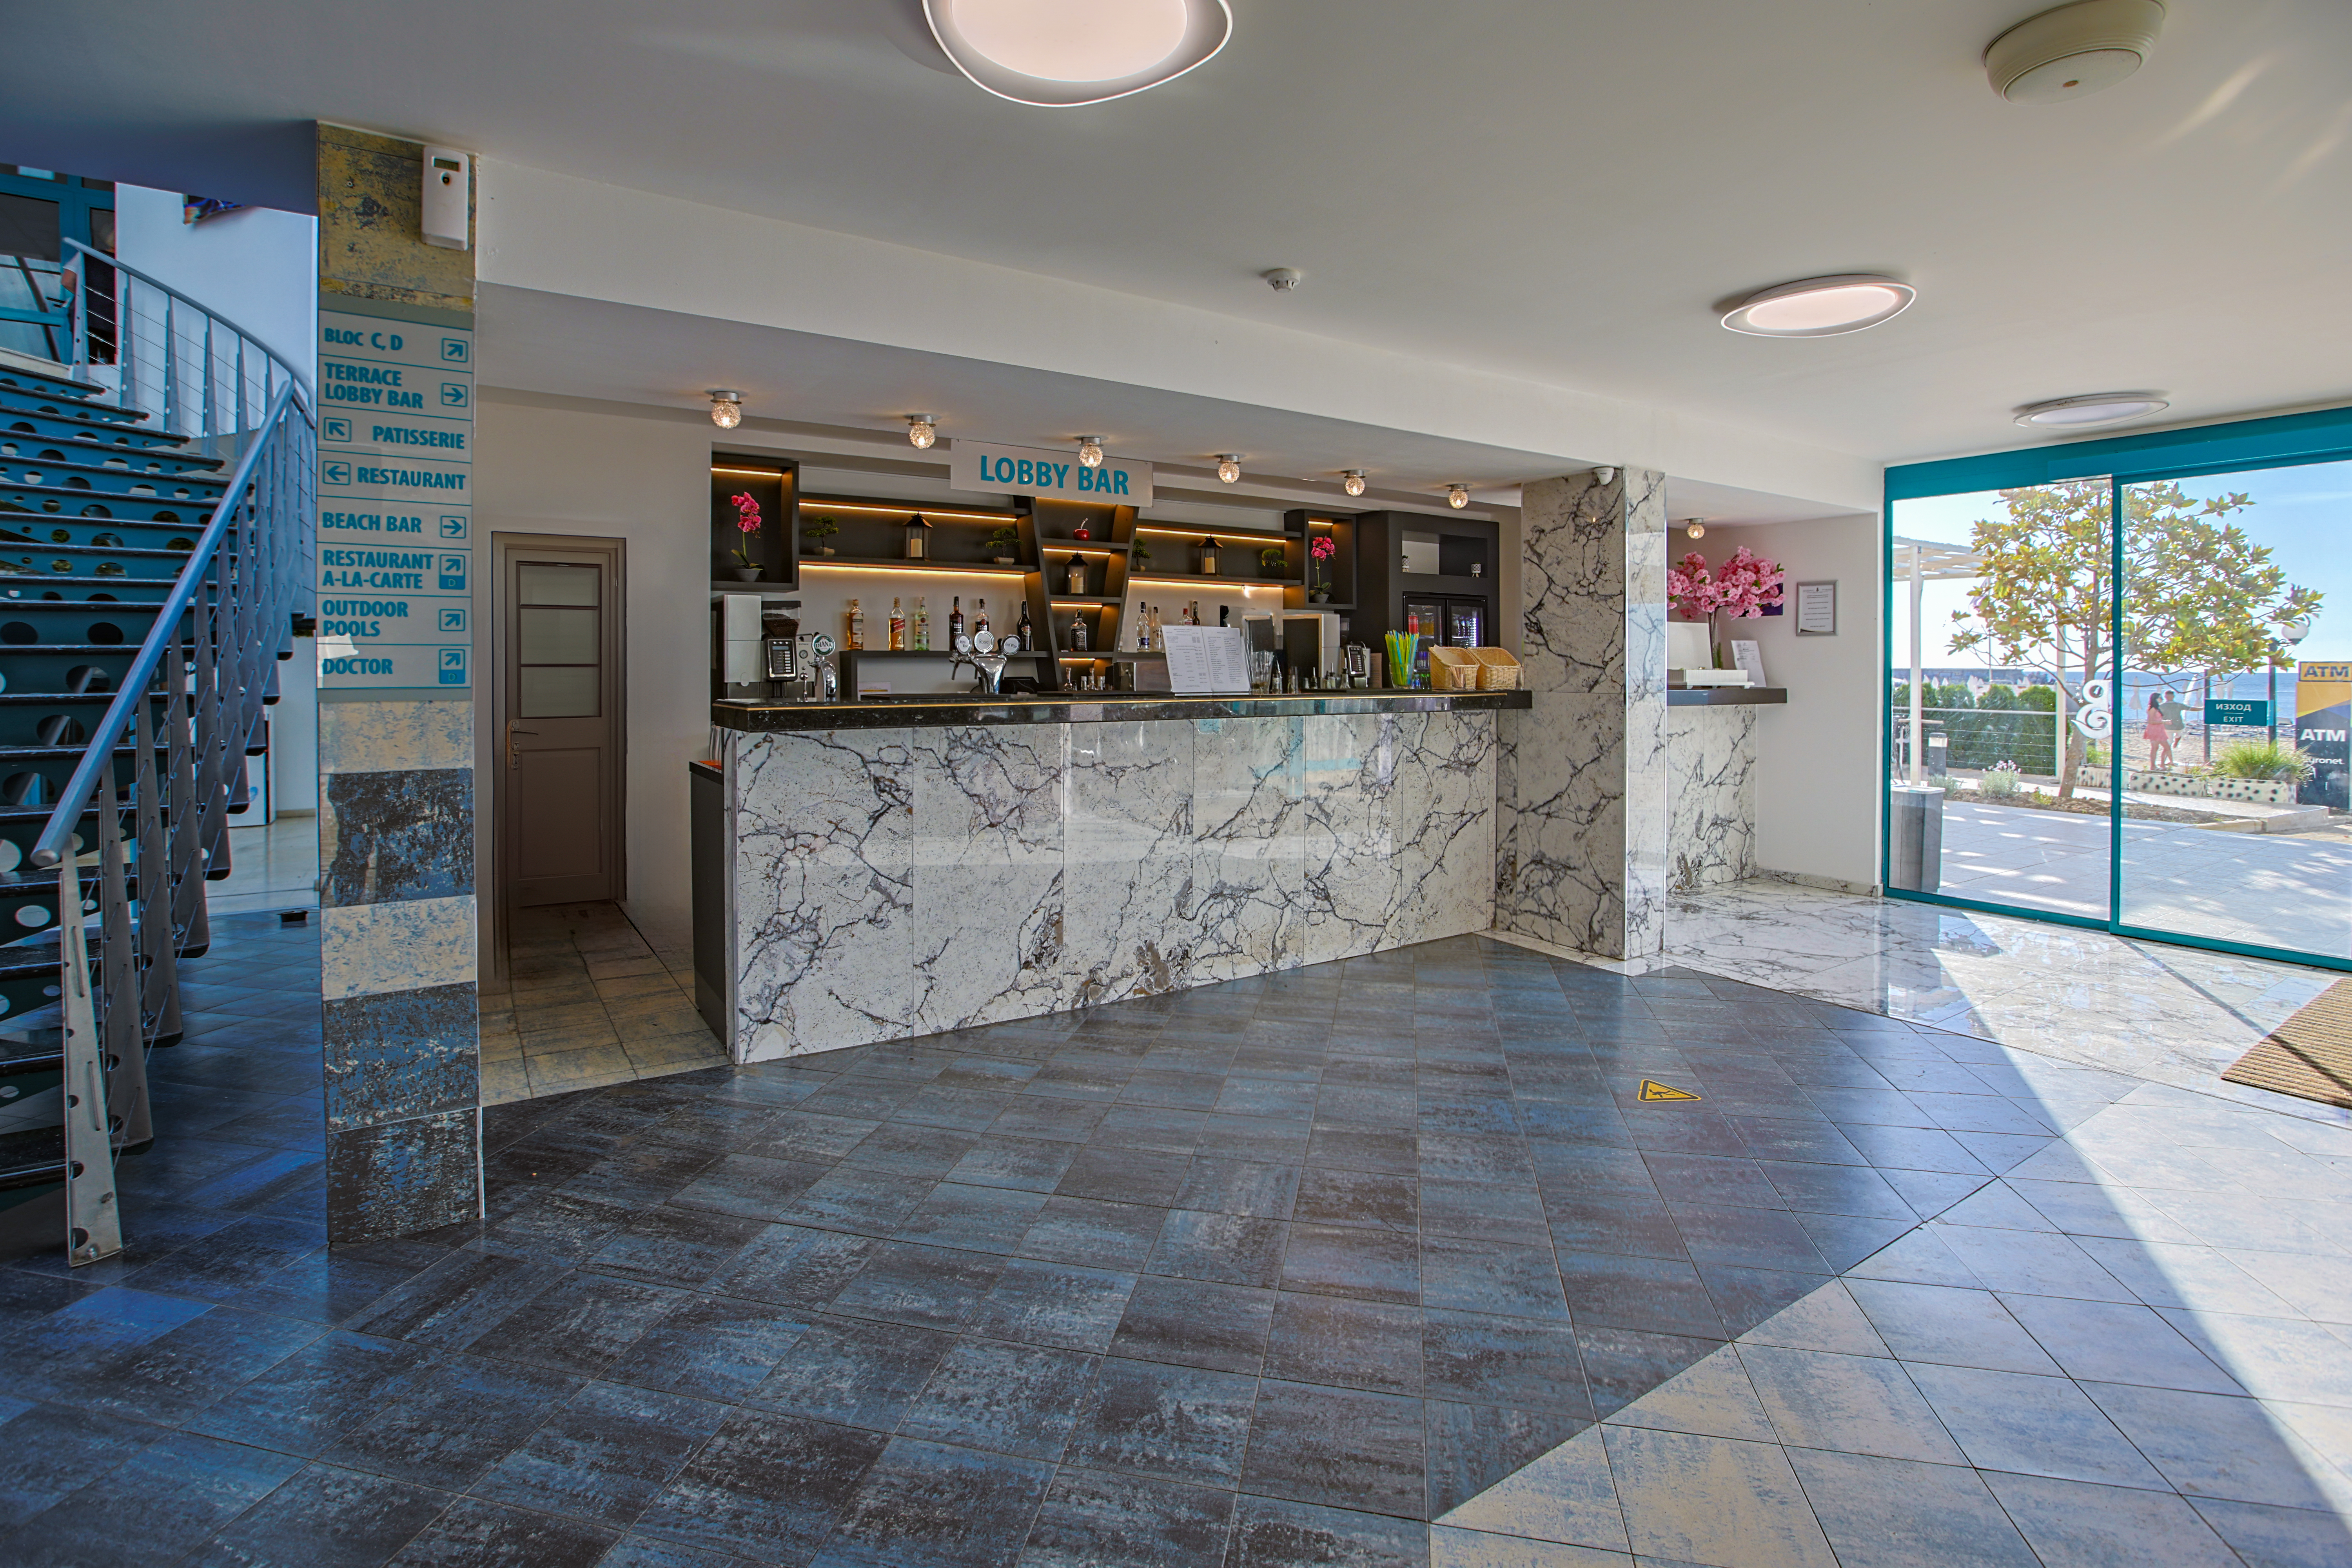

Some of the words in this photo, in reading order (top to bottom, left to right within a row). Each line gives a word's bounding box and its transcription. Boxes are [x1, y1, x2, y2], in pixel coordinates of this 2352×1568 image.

[324, 328, 364, 346] BLOC
[390, 334, 403, 350] D
[324, 362, 402, 387] TERRACE
[325, 383, 383, 404] LOBBY
[387, 390, 423, 408] BAR
[372, 425, 465, 449] PATISSERIE
[357, 467, 466, 490] RESTAURANT
[980, 455, 1070, 488] LOBBY
[1078, 466, 1129, 495] BAR
[322, 512, 381, 531] BEACH
[386, 516, 422, 533] BAR
[323, 550, 434, 570] RESTAURANT
[322, 570, 423, 589] A-LA-CARTE
[322, 600, 408, 617] OUTDOOR
[323, 620, 381, 637] POOLS
[323, 659, 393, 675] DOCTOR
[2304, 666, 2349, 677] ATM
[2216, 704, 2252, 712] ИЗХОД
[2300, 728, 2346, 742] ATM
